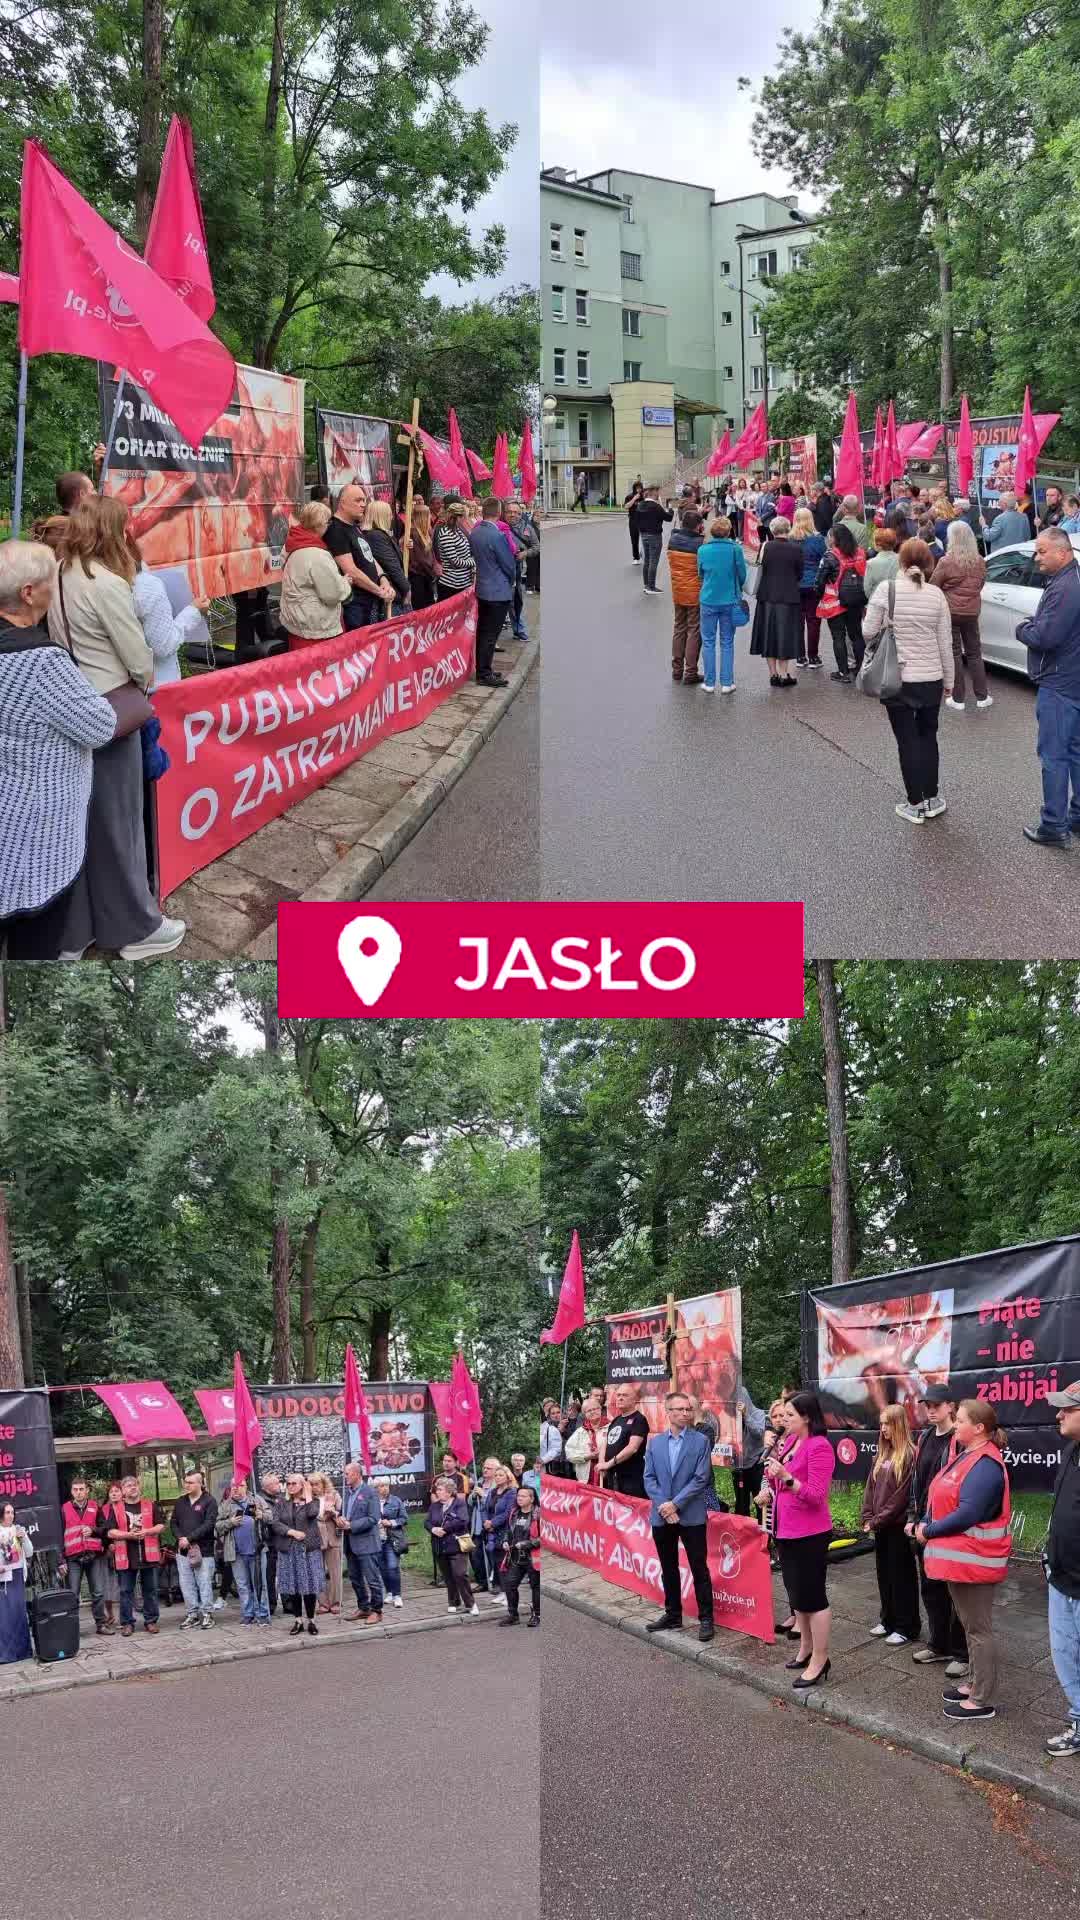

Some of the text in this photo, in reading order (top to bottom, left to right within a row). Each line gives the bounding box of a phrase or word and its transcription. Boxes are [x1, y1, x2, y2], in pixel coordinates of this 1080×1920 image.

[140, 402, 177, 428] MILI
[115, 436, 225, 463] OFIAR ROCZNIE
[183, 641, 378, 764] PUBLICZNY
[180, 786, 219, 841] O
[231, 678, 413, 820] ZATRZYMANIE
[978, 1296, 1041, 1328] Piąte
[611, 1350, 619, 1360] 73
[996, 1331, 1035, 1362] nie
[256, 1391, 425, 1418] LUDOBÓSTWO
[0, 1424, 16, 1440] te
[860, 1442, 880, 1453] ŻYCI
